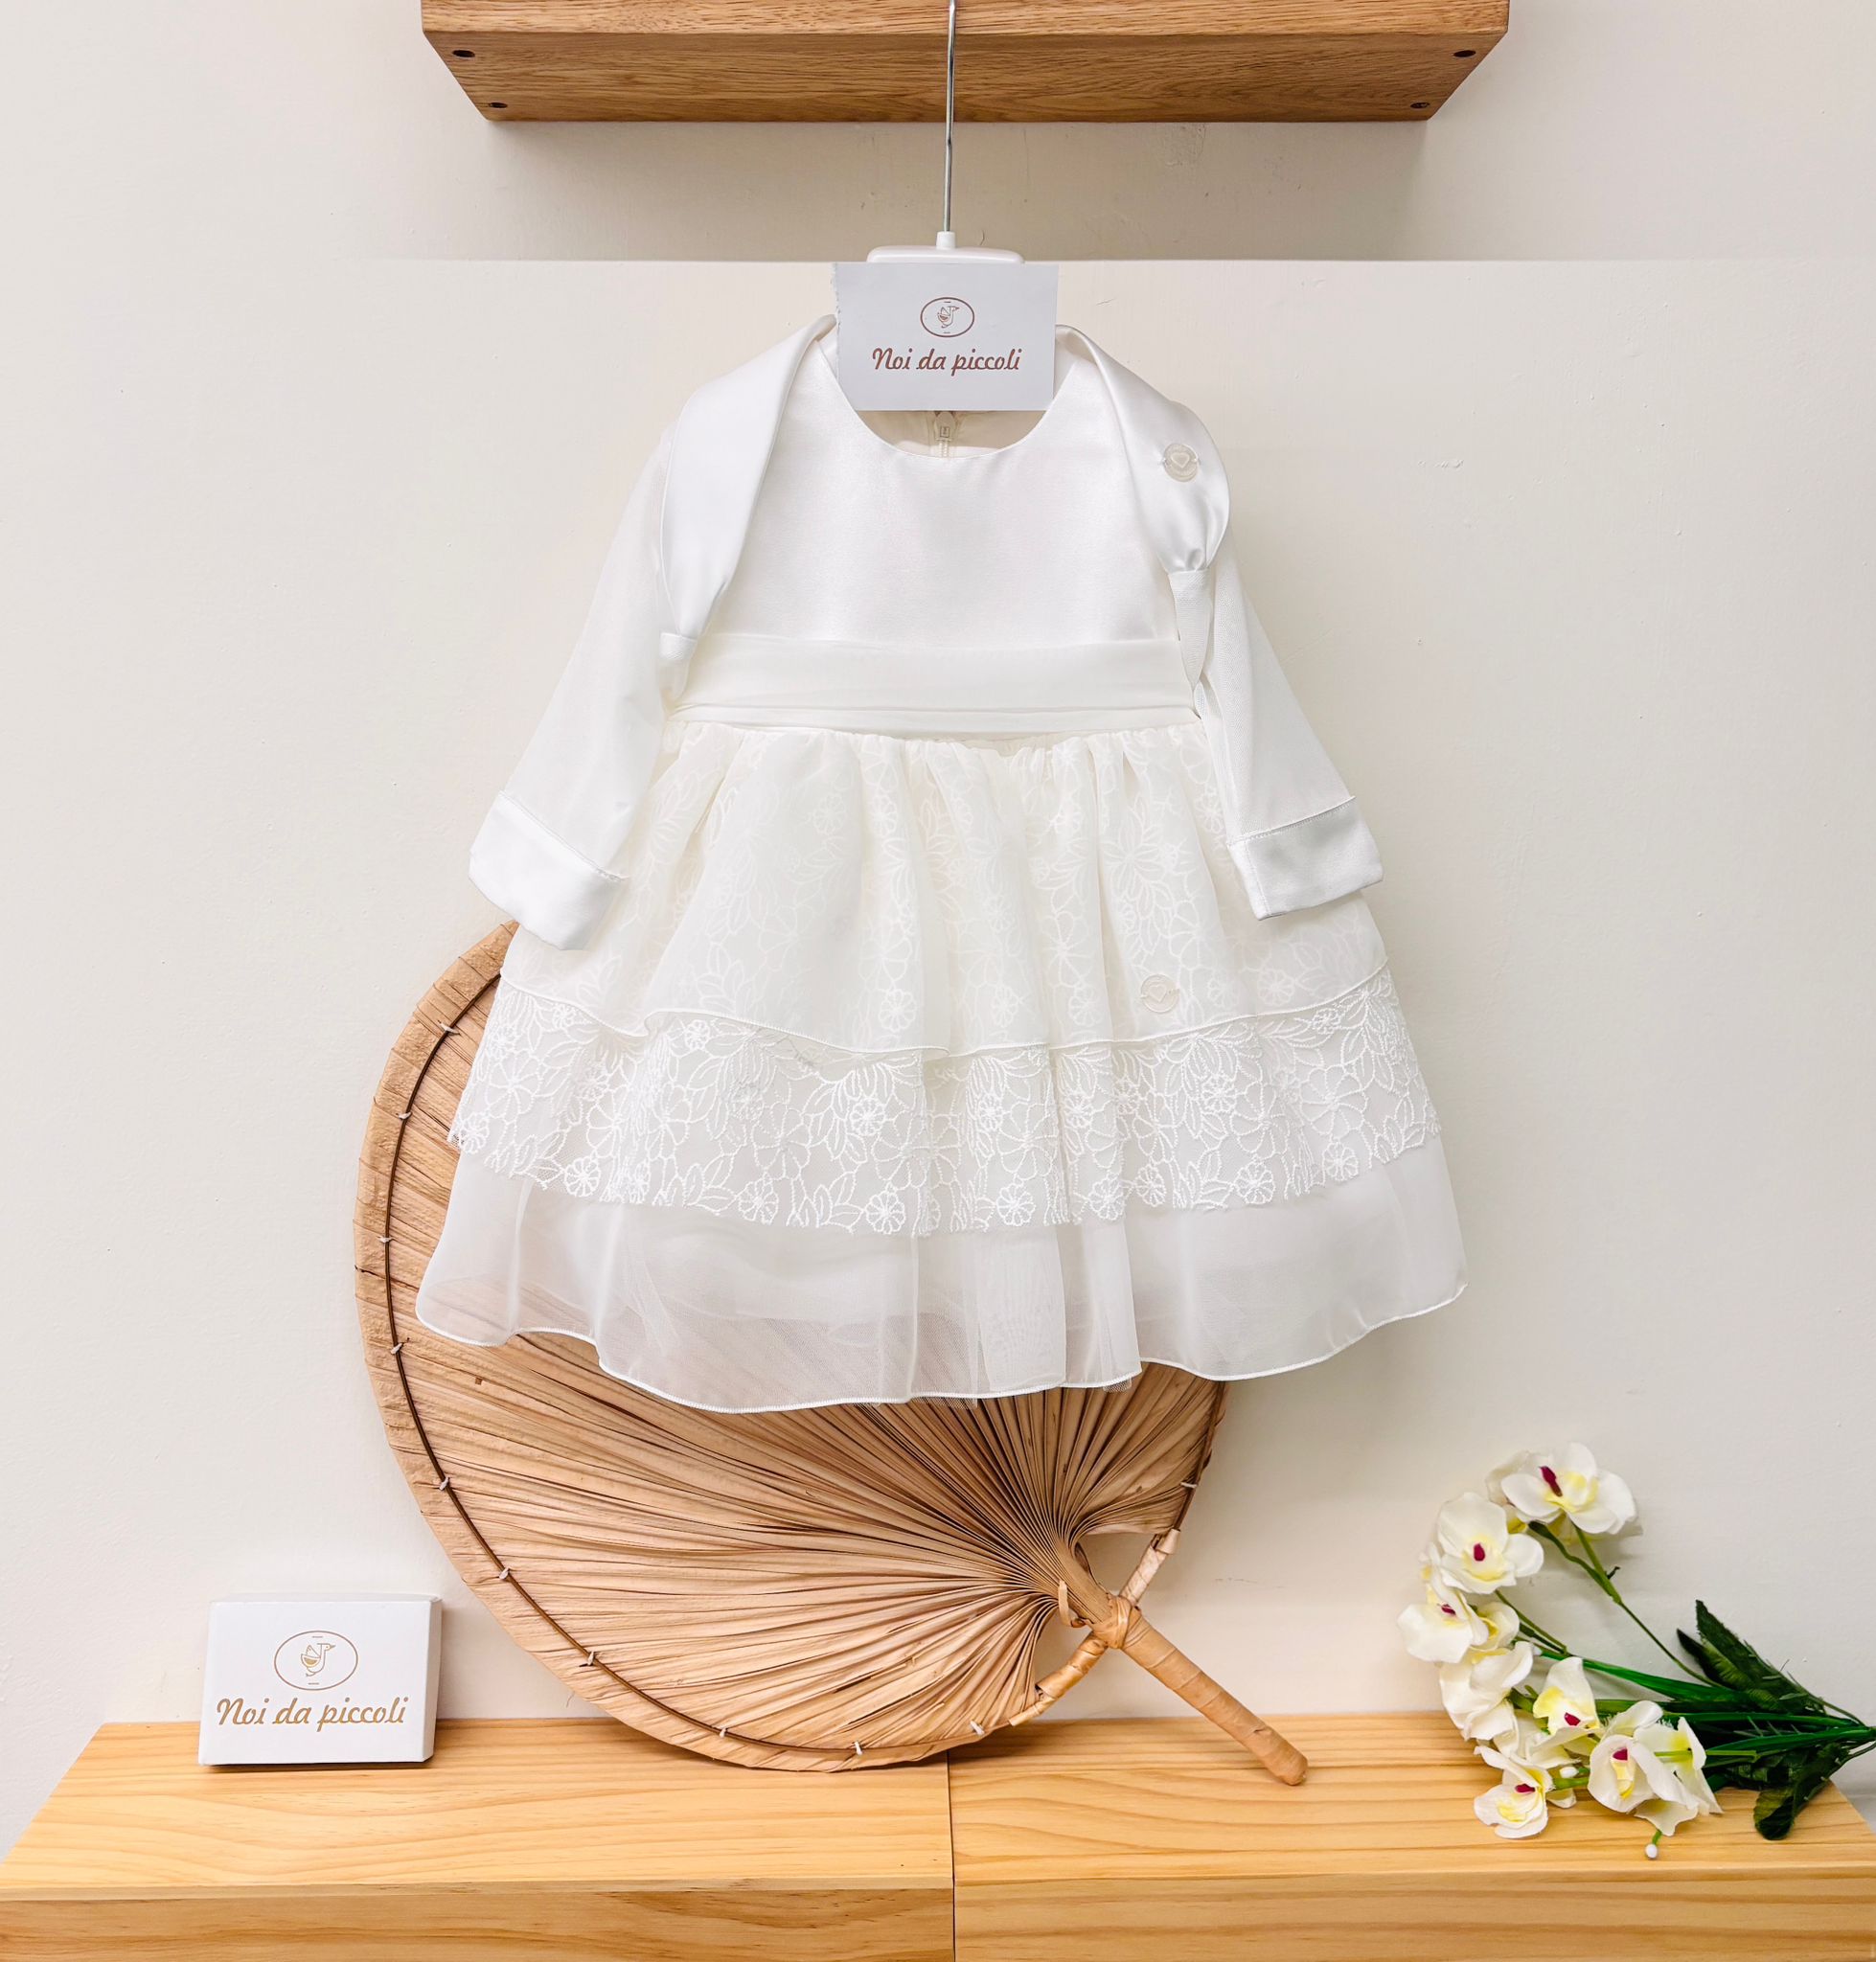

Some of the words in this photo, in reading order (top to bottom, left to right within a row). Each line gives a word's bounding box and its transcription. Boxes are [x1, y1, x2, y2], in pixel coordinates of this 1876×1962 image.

[872, 347, 913, 371] Noi
[916, 348, 947, 371] da
[950, 348, 1022, 376] piccoli
[217, 1697, 269, 1725] Noi
[272, 1698, 311, 1724] da
[316, 1697, 409, 1732] piccoli
